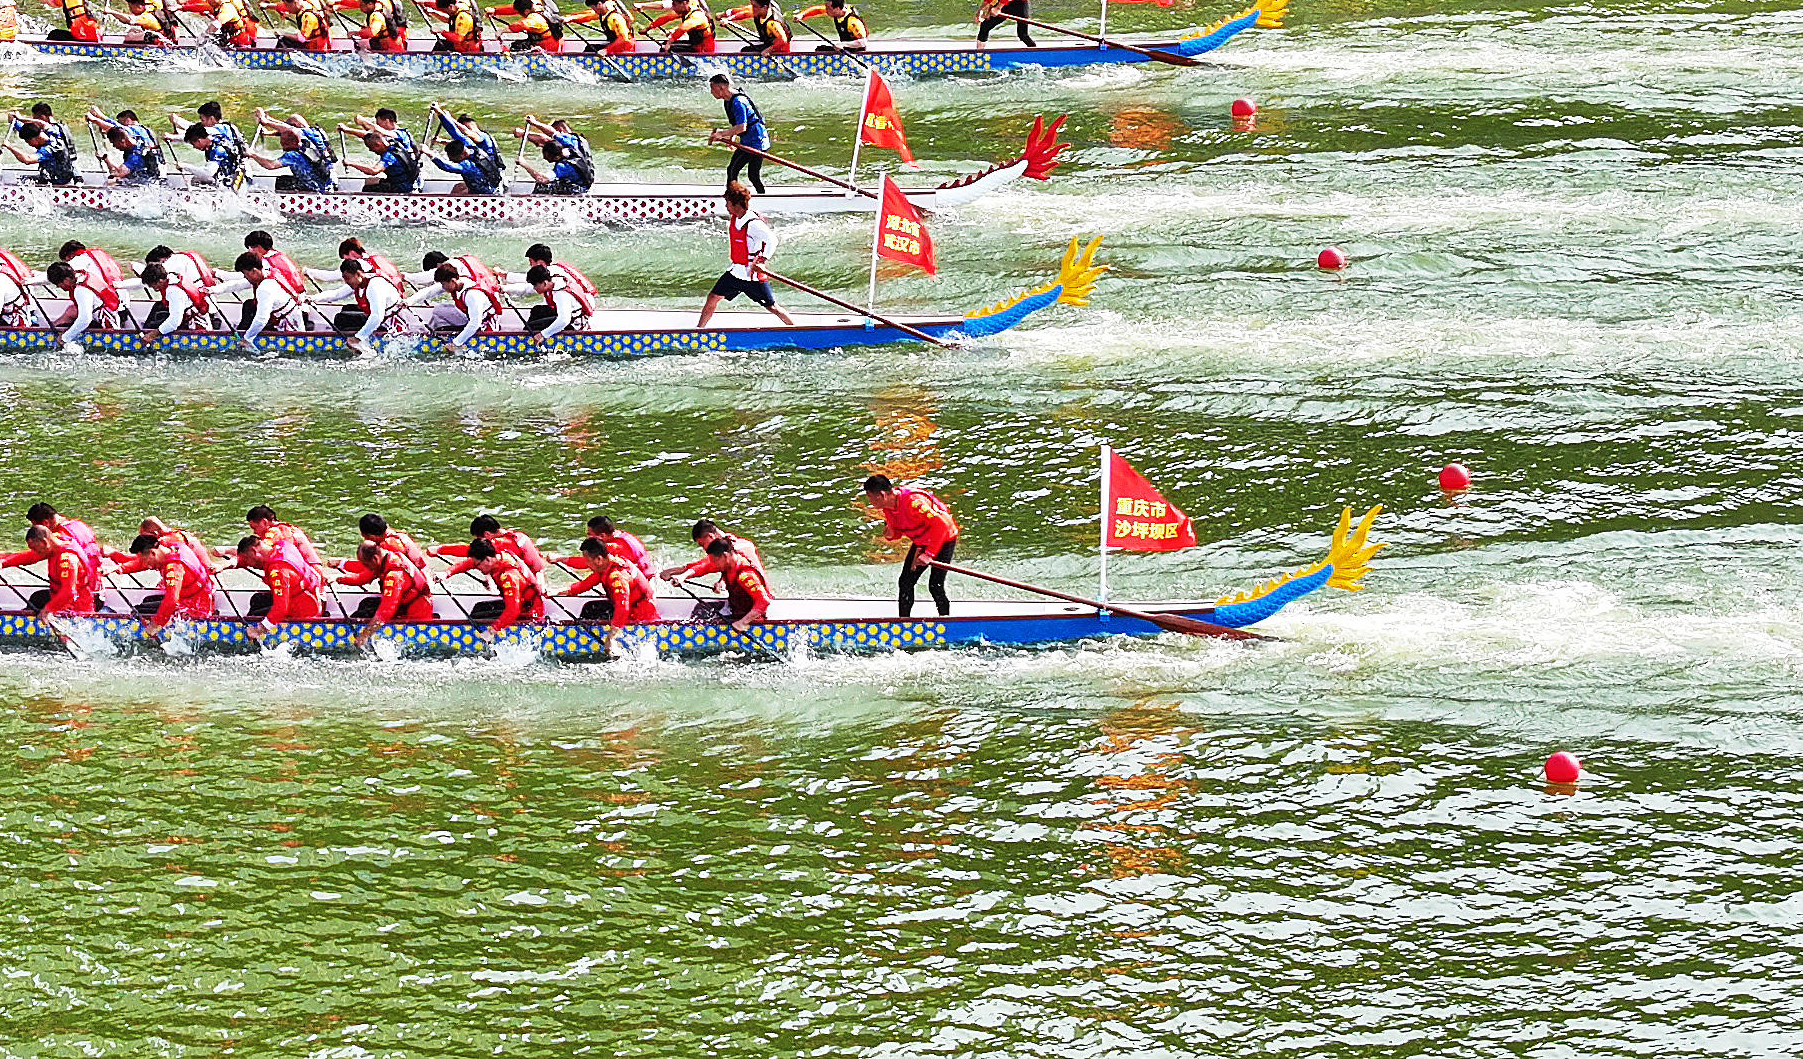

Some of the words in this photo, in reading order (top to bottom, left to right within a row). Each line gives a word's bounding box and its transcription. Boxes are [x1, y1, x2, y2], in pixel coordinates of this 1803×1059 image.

[883, 233, 921, 256] 武汉市
[1115, 496, 1168, 519] 重庆市
[1114, 518, 1180, 540] 沙坪坝区
